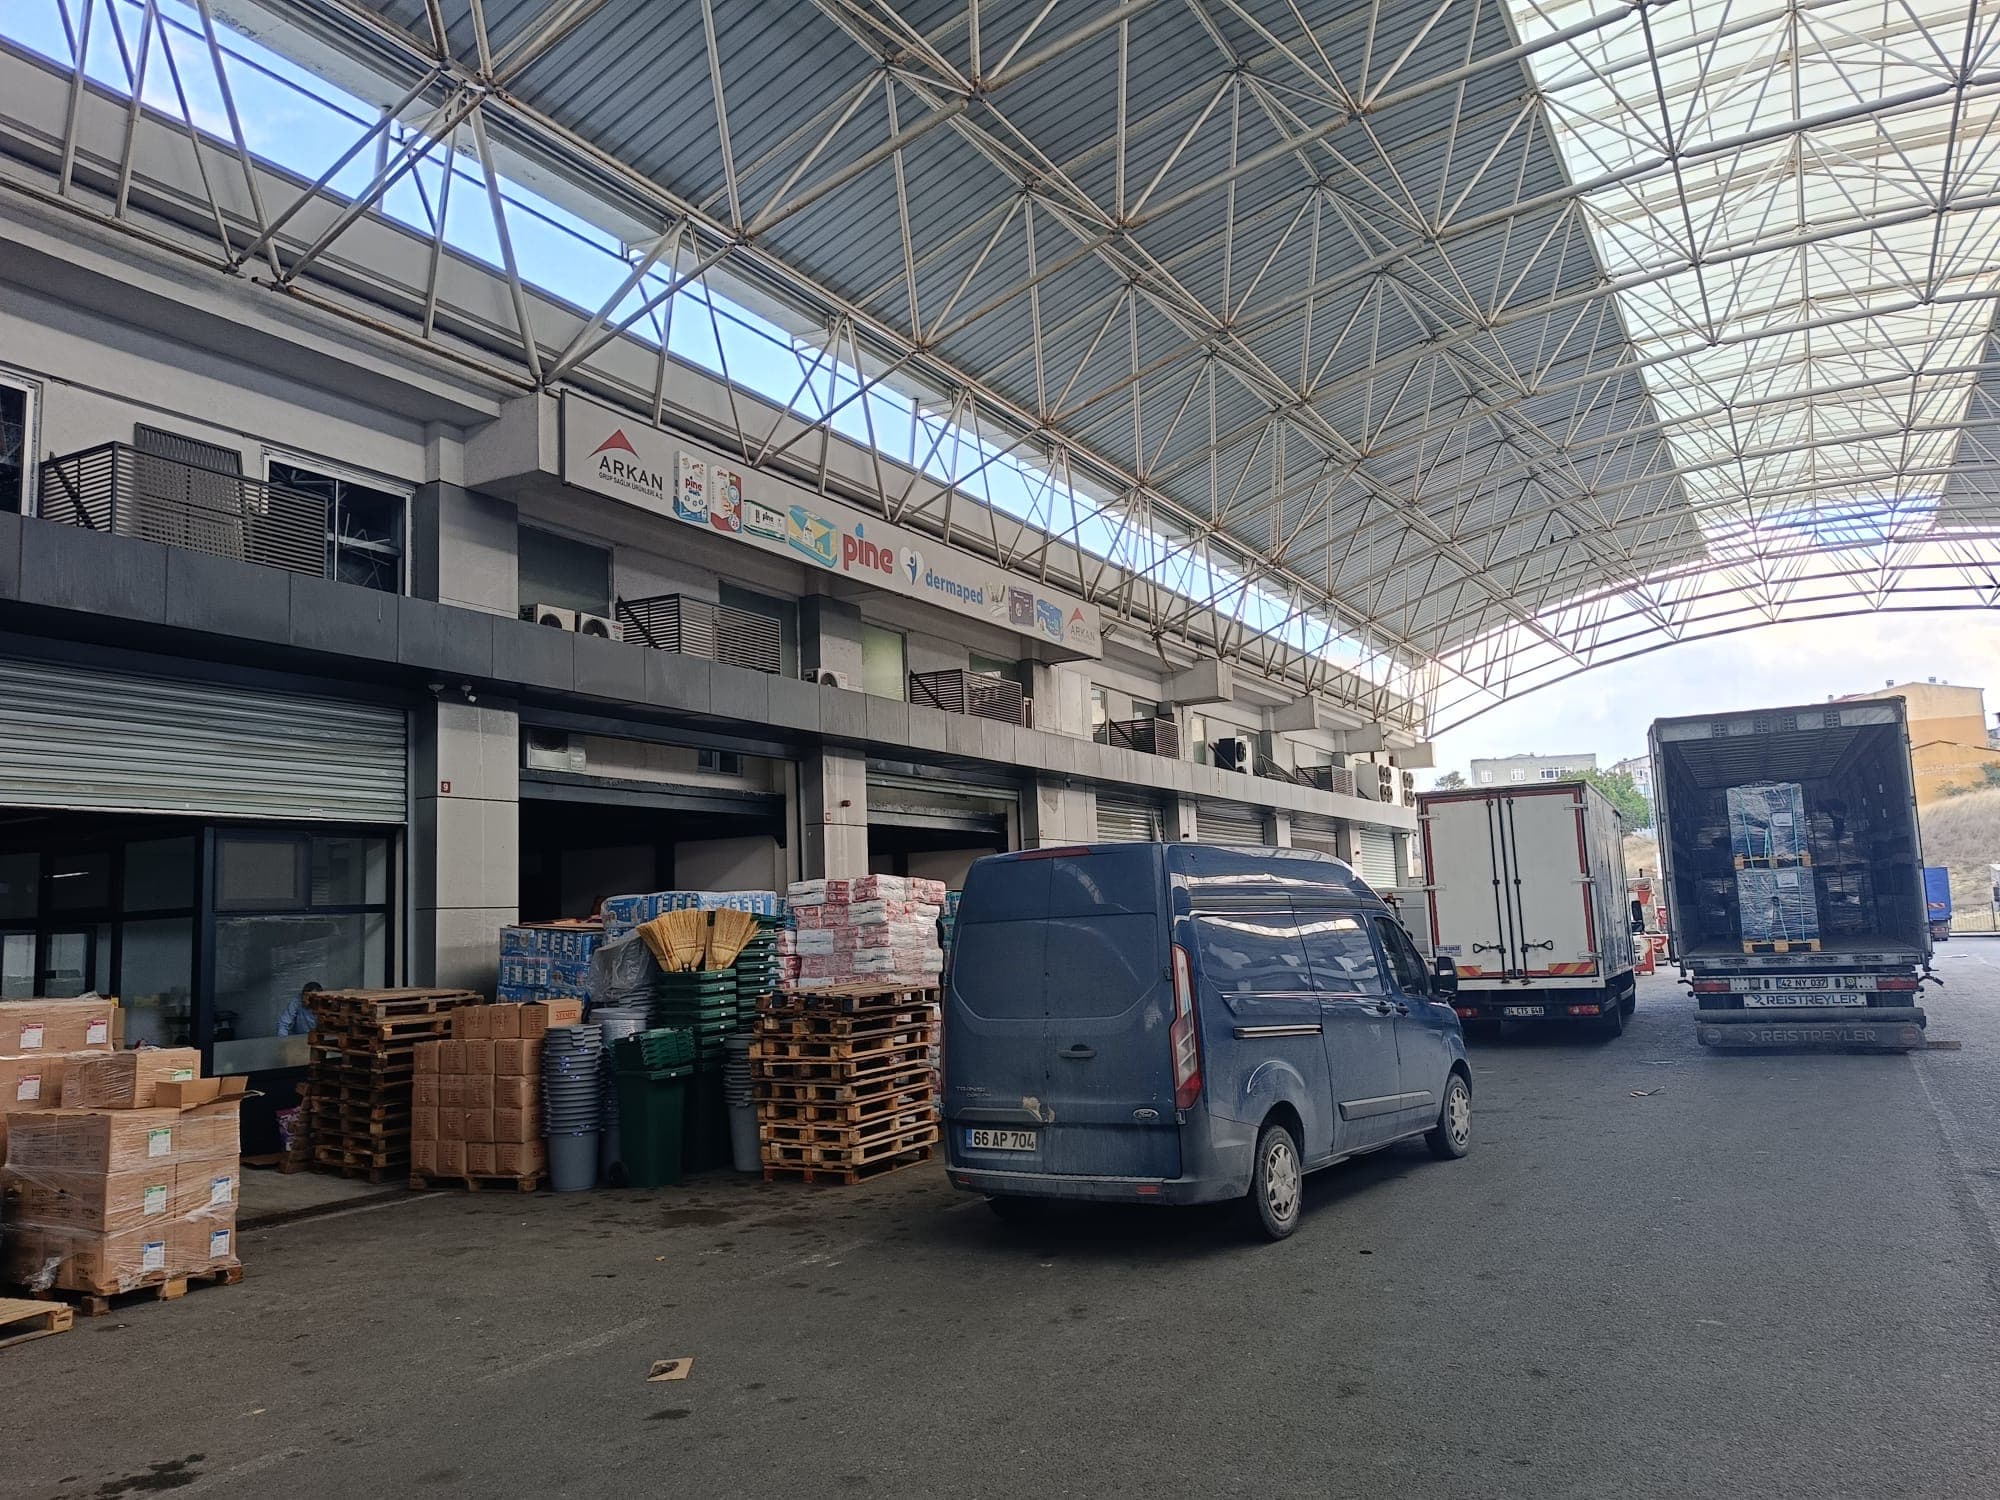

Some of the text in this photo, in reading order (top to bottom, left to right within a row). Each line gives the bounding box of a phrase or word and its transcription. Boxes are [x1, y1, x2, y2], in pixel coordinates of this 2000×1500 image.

[600, 455, 663, 491] ARKAN
[685, 475, 703, 491] pine
[843, 523, 893, 574] pine
[925, 568, 983, 605] dermaped
[1071, 624, 1095, 641] ARKAN
[1782, 978, 1826, 987] 42 NY 037
[973, 1131, 1035, 1149] 66 AP 704
